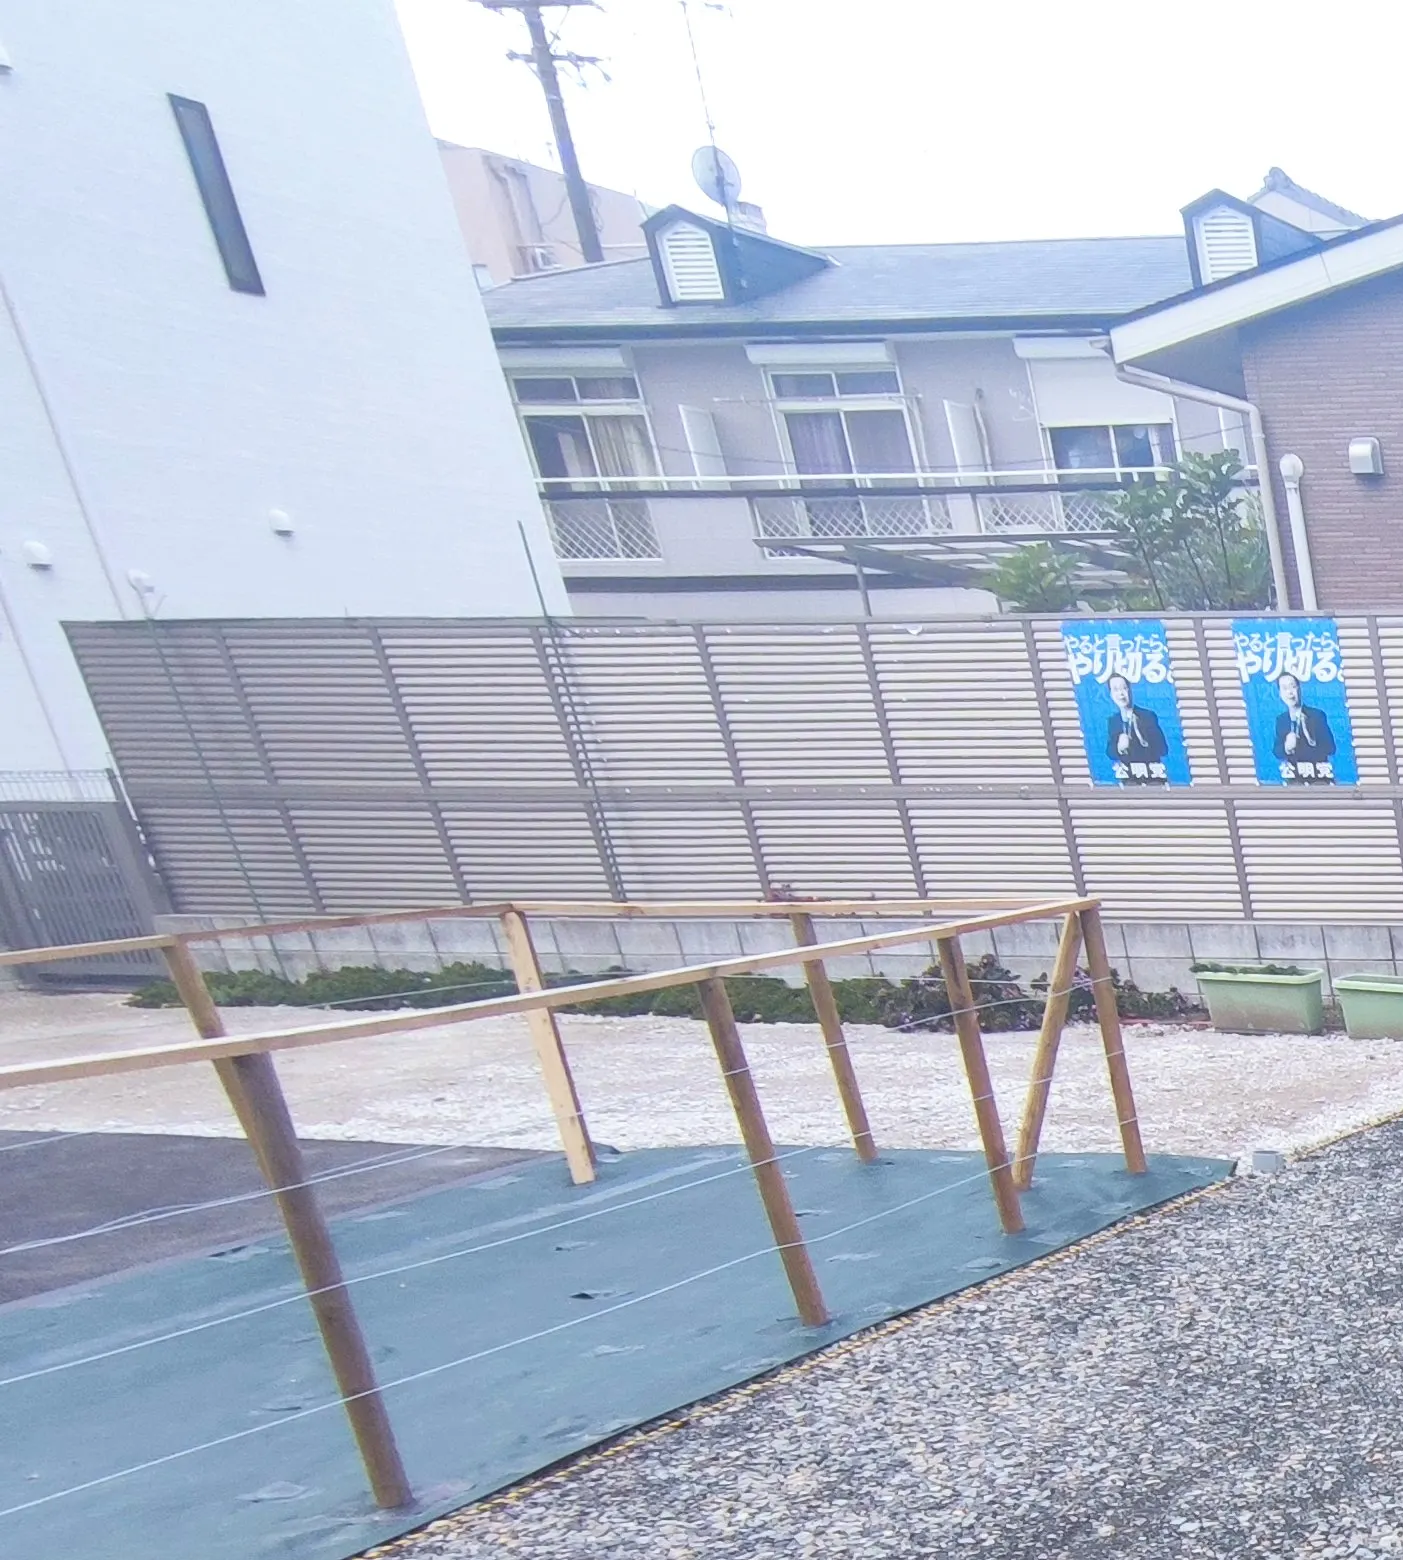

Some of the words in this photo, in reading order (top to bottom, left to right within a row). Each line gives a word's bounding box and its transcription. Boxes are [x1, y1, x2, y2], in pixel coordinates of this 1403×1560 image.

[1113, 762, 1168, 779] 公明党
[1279, 761, 1334, 779] 公明党
